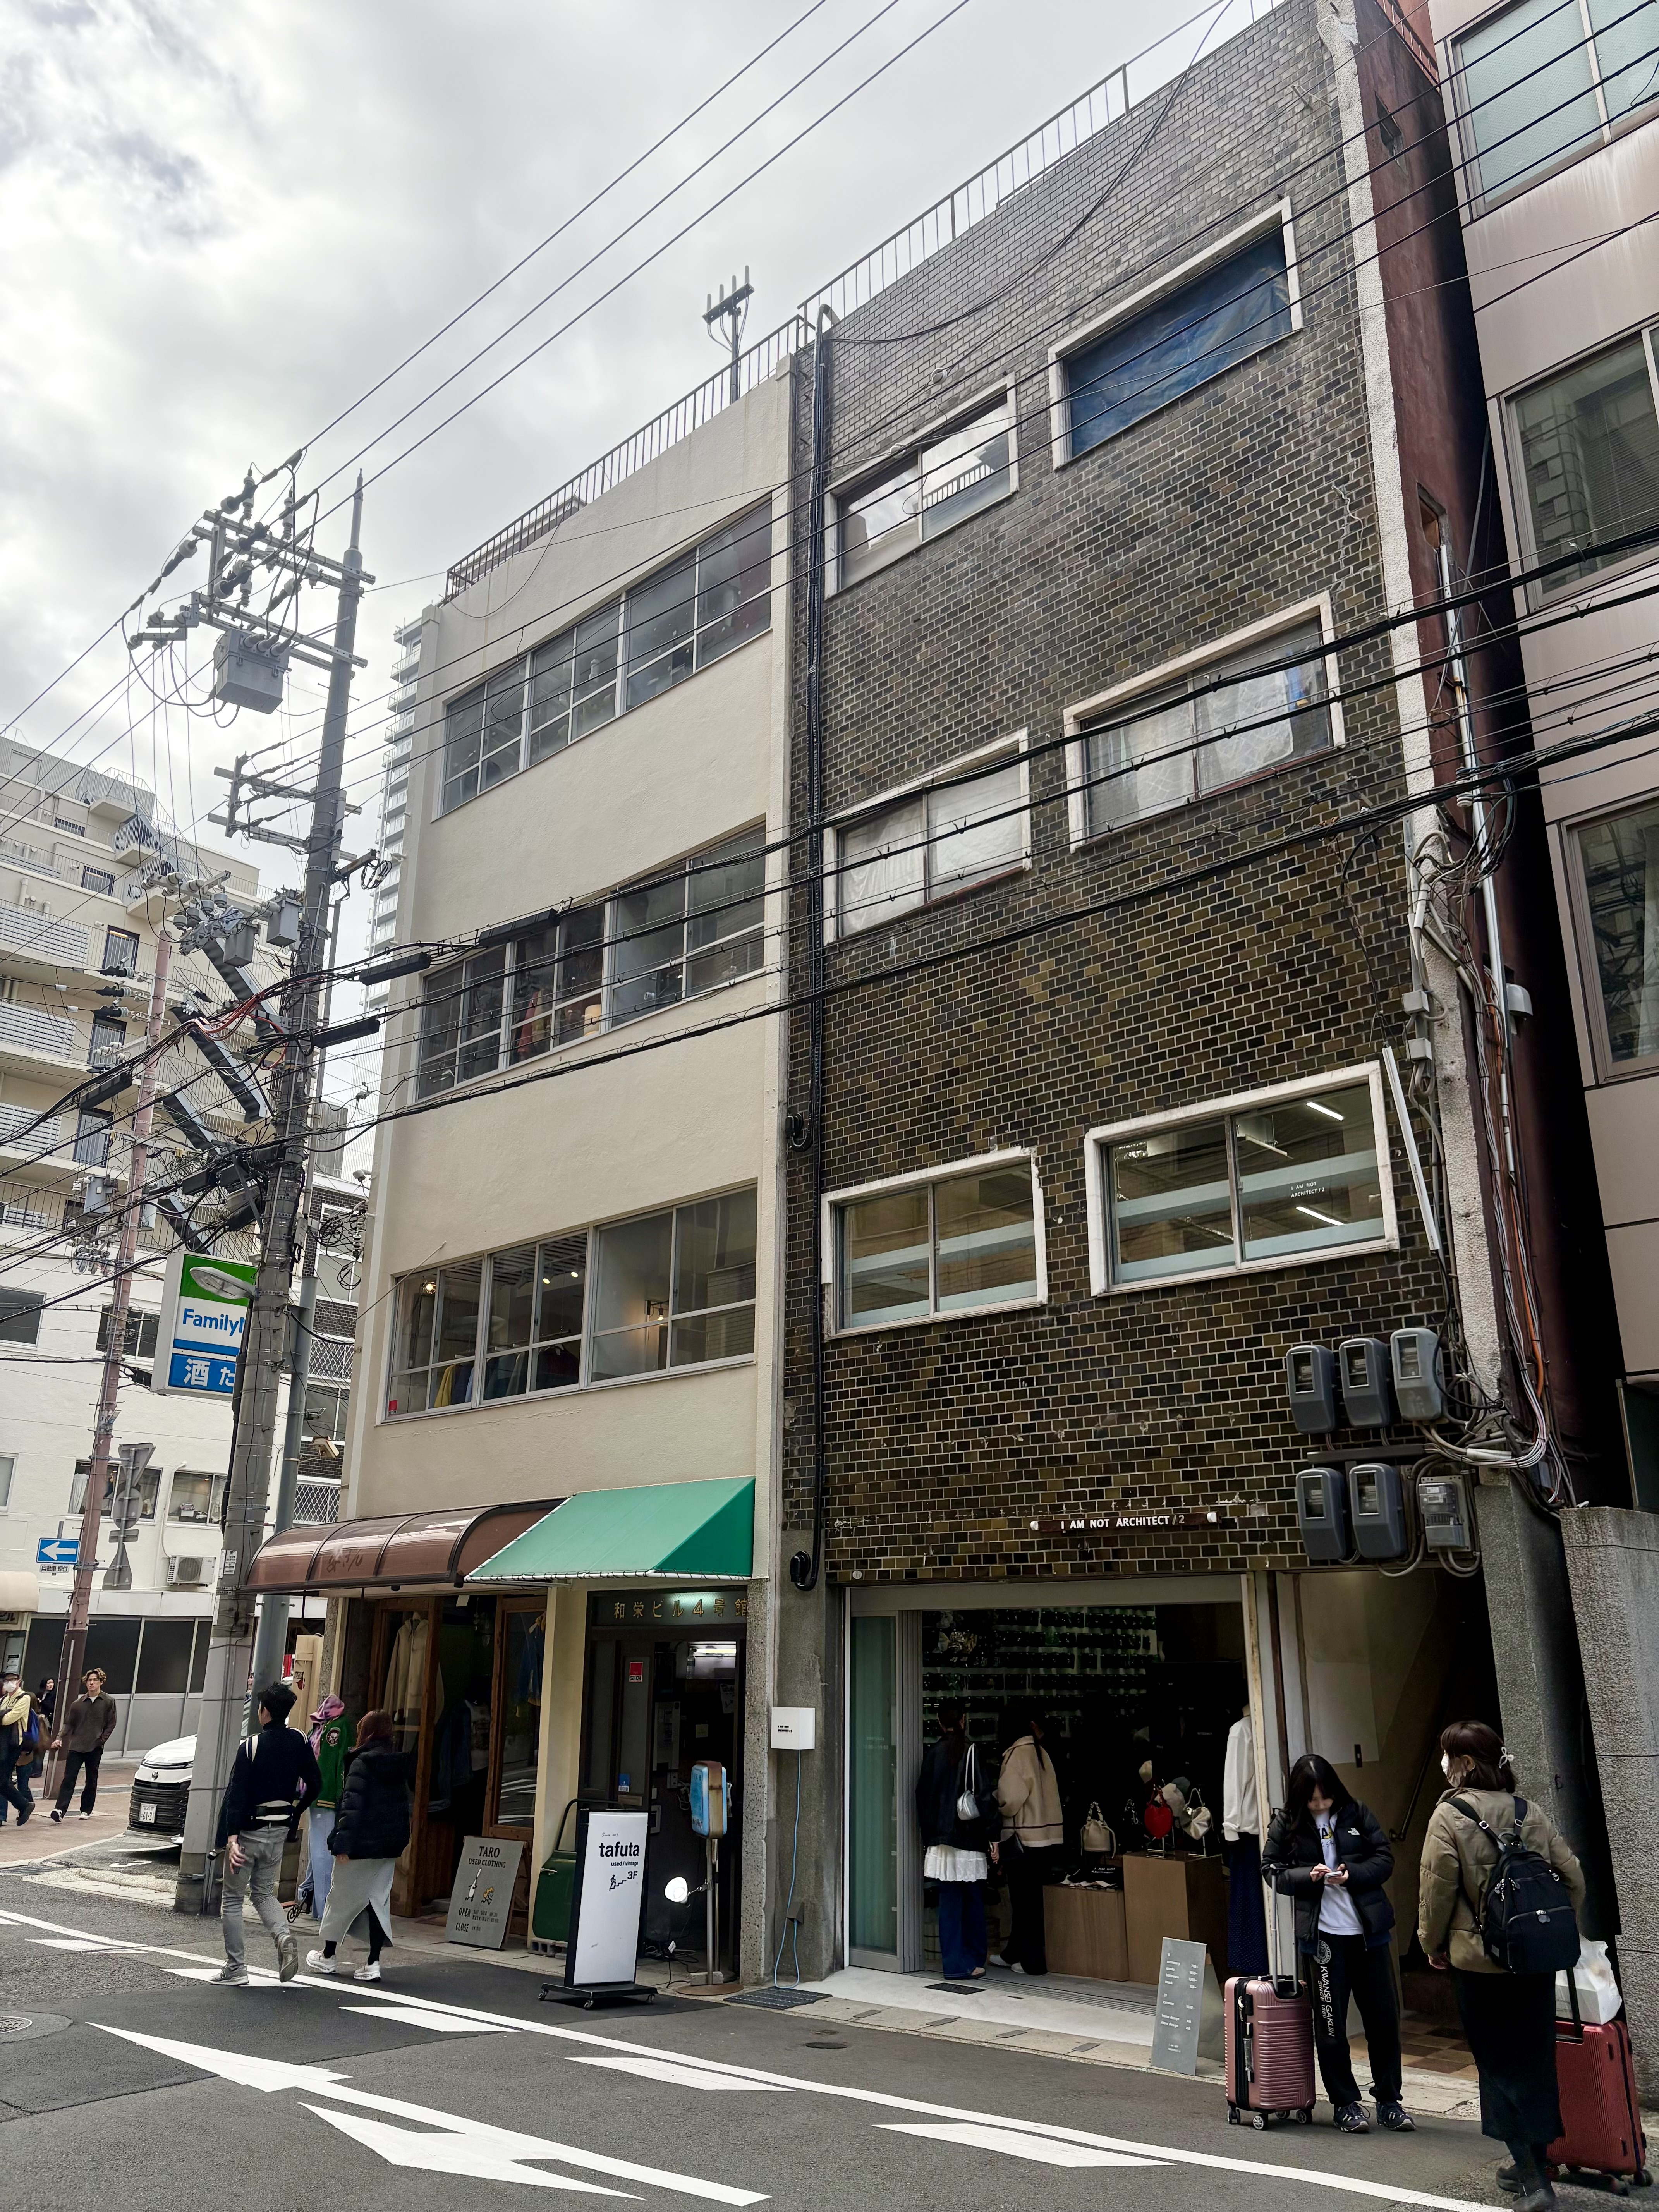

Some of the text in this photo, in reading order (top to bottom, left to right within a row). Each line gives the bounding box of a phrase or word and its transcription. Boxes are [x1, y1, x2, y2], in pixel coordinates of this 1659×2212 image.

[1291, 1188, 1317, 1198] ARCHITECT
[1061, 1521, 1064, 1529] I
[1070, 1520, 1085, 1529] AM
[1090, 1519, 1110, 1528] NOT
[1116, 1516, 1170, 1527] ARCHITECT
[479, 1846, 500, 1858] TARO
[599, 1841, 639, 1857] tafuta
[482, 1860, 506, 1868] CLOTHING
[627, 1871, 638, 1879] 3F
[459, 1908, 471, 1917] OPEN
[455, 1922, 469, 1932] CLOSE
[1326, 2005, 1335, 2037] GAKUIN
